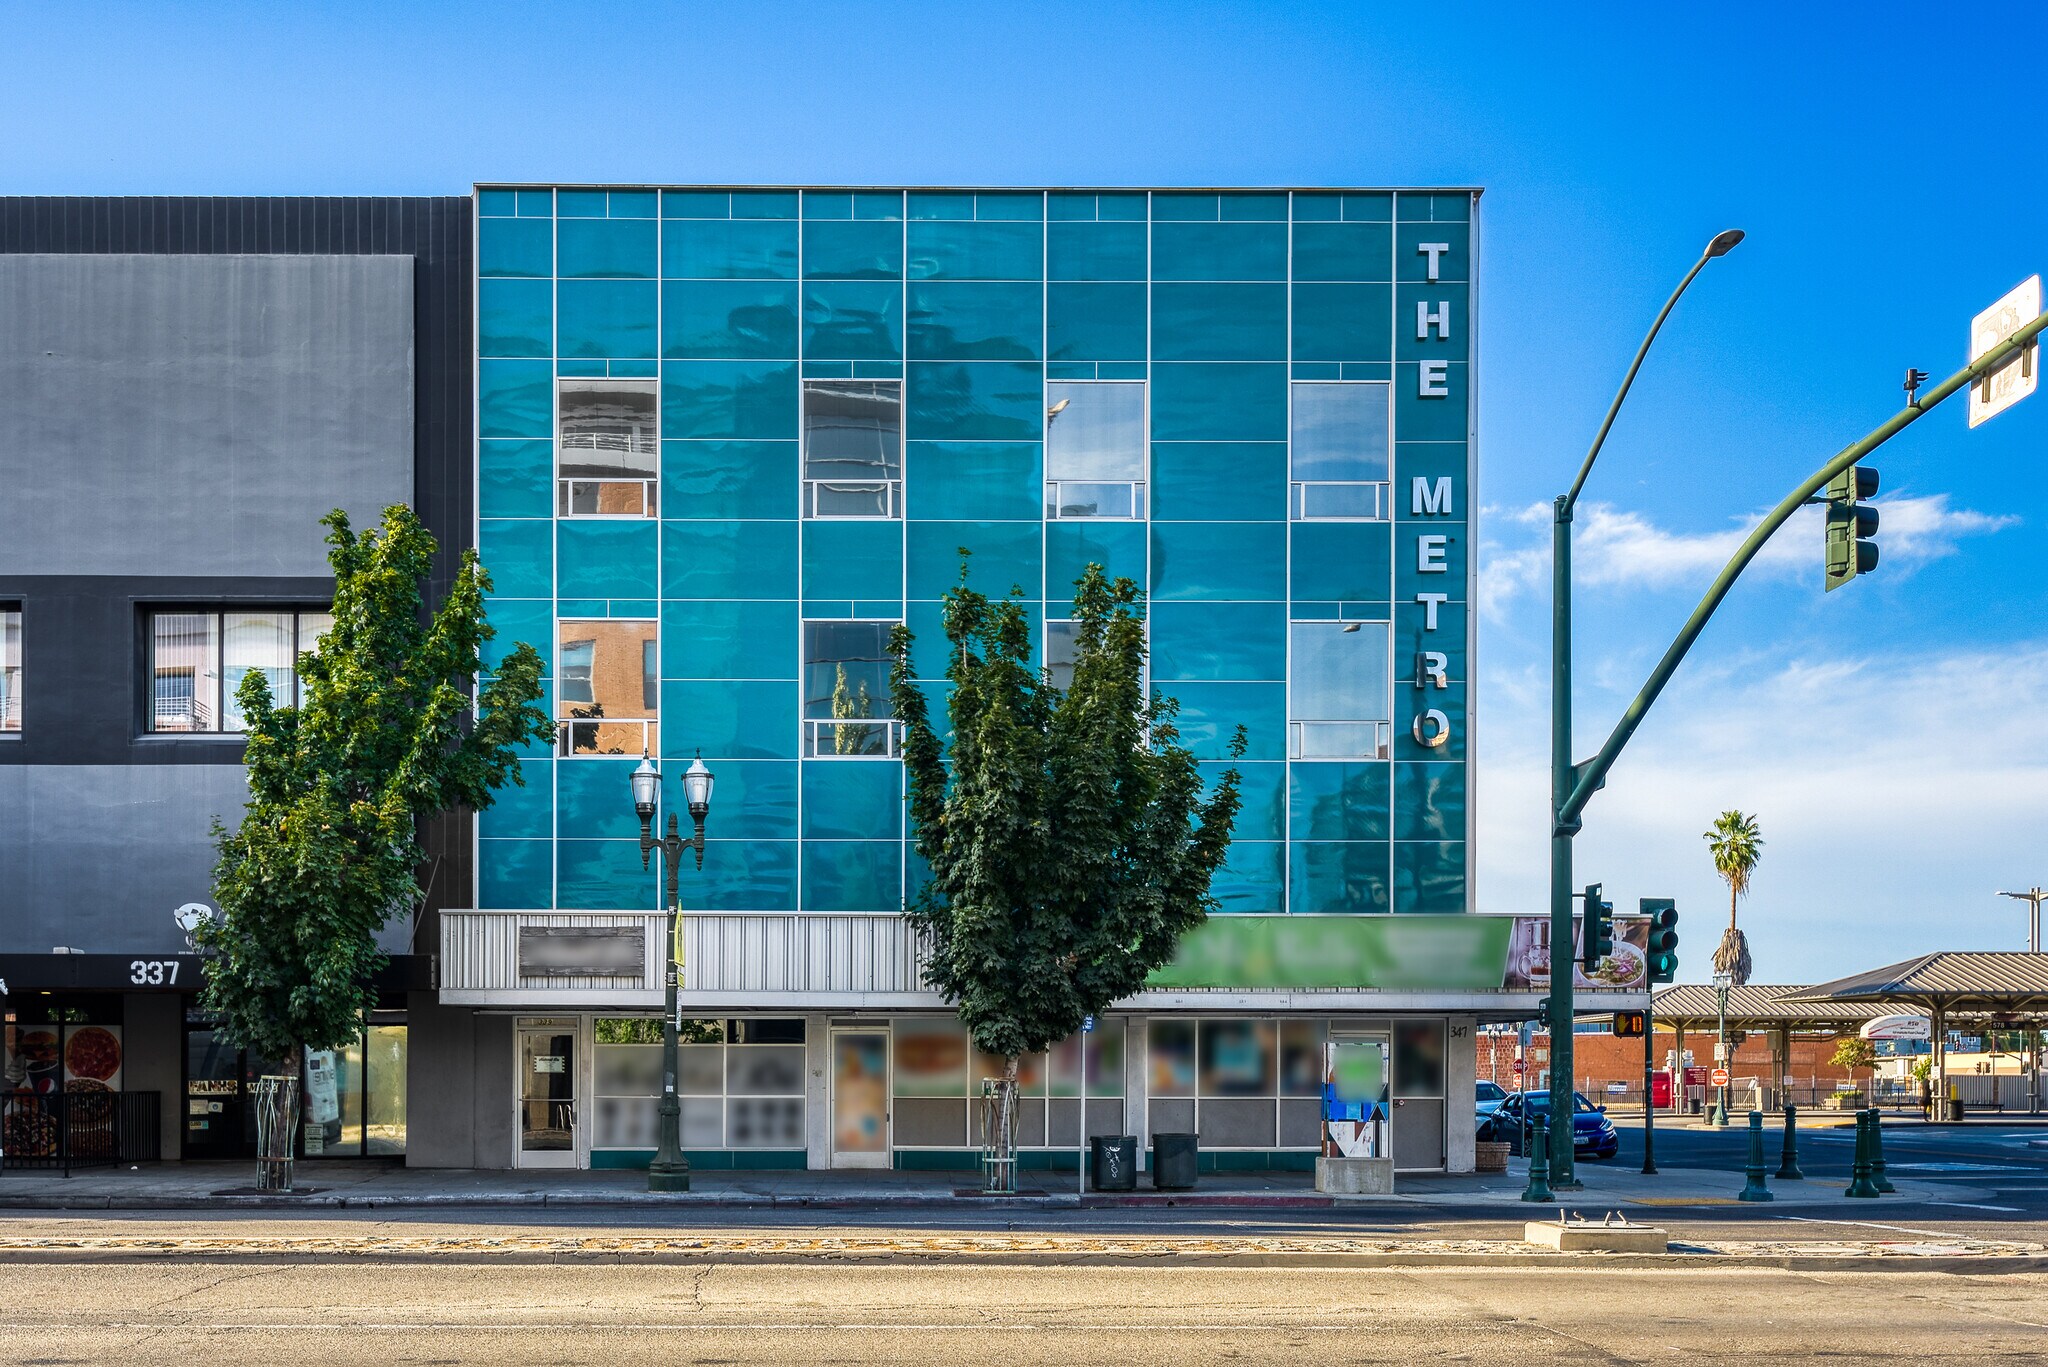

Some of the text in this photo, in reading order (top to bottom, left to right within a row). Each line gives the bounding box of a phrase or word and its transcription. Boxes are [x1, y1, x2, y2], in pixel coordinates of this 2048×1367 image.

[1411, 242, 1453, 748] THE METRO
[130, 960, 180, 985] 337
[1450, 1025, 1468, 1038] 347
